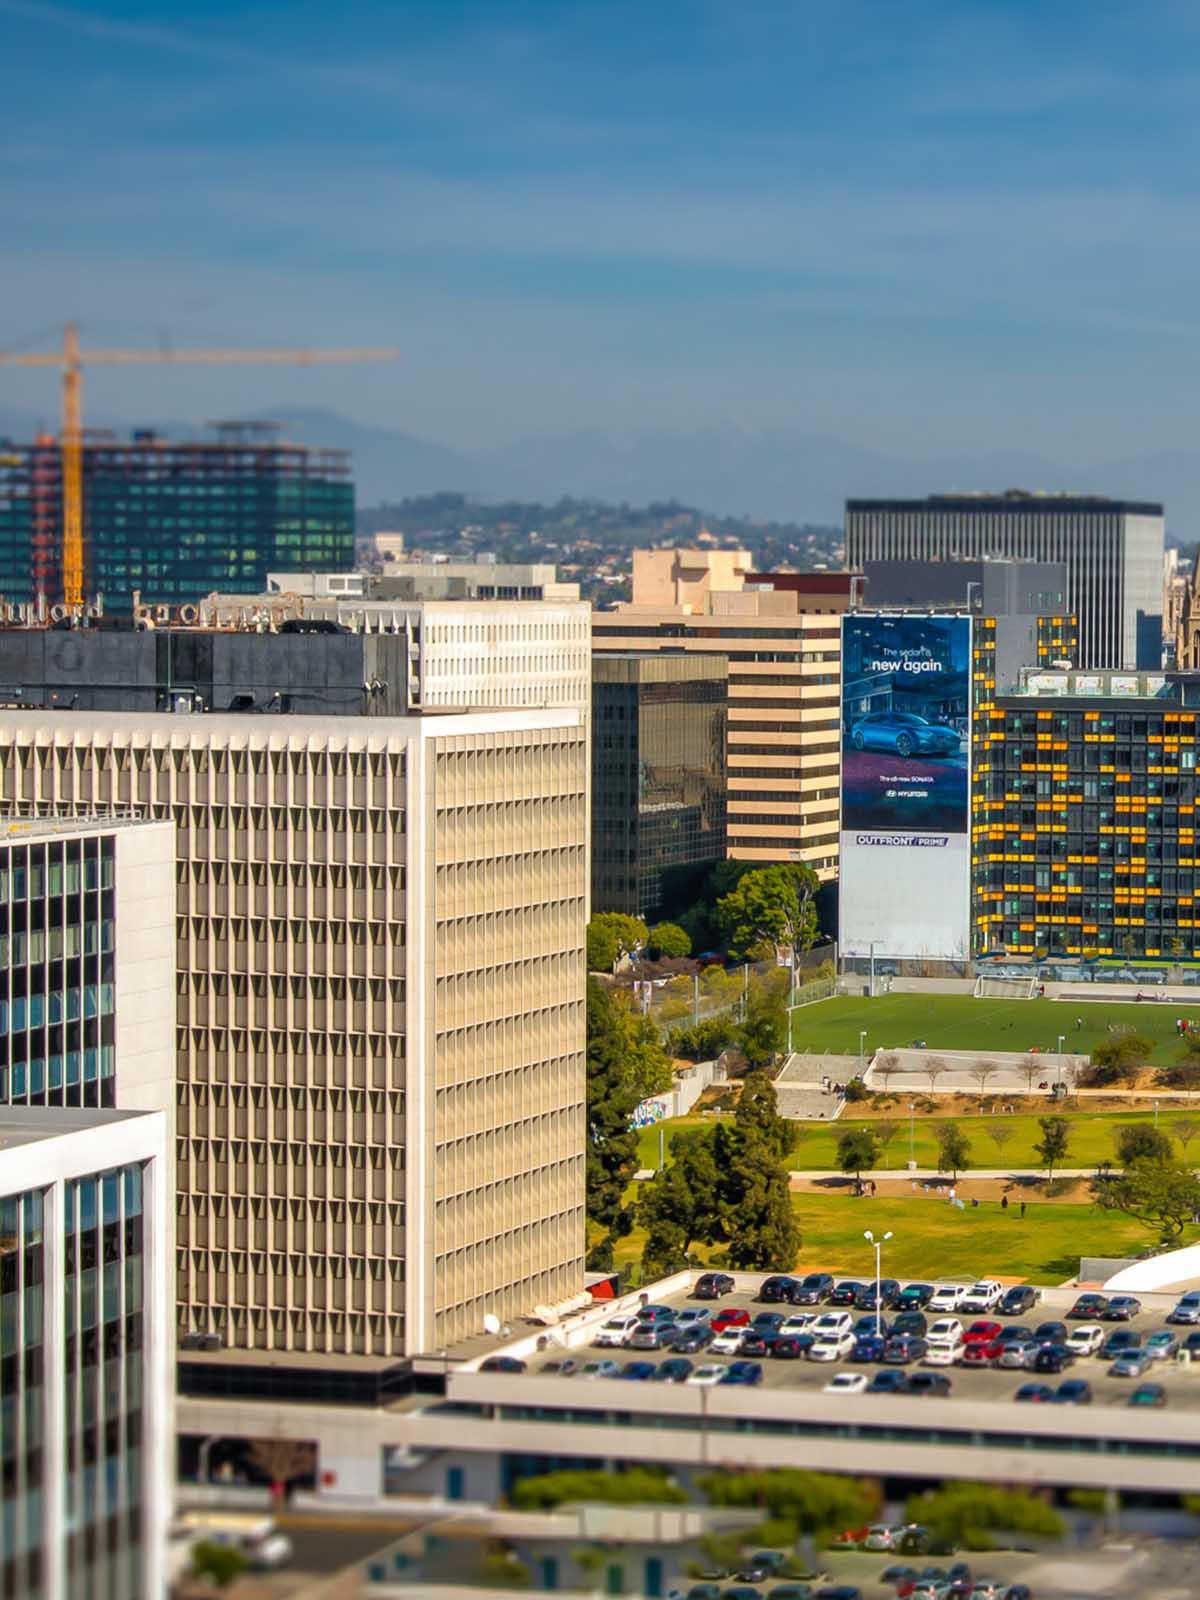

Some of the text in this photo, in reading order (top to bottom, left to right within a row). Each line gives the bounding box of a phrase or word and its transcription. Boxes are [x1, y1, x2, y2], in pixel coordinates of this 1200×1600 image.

[883, 647, 898, 656] The
[872, 658, 942, 674] new again
[857, 836, 946, 846] OUTFRONT PRIME
